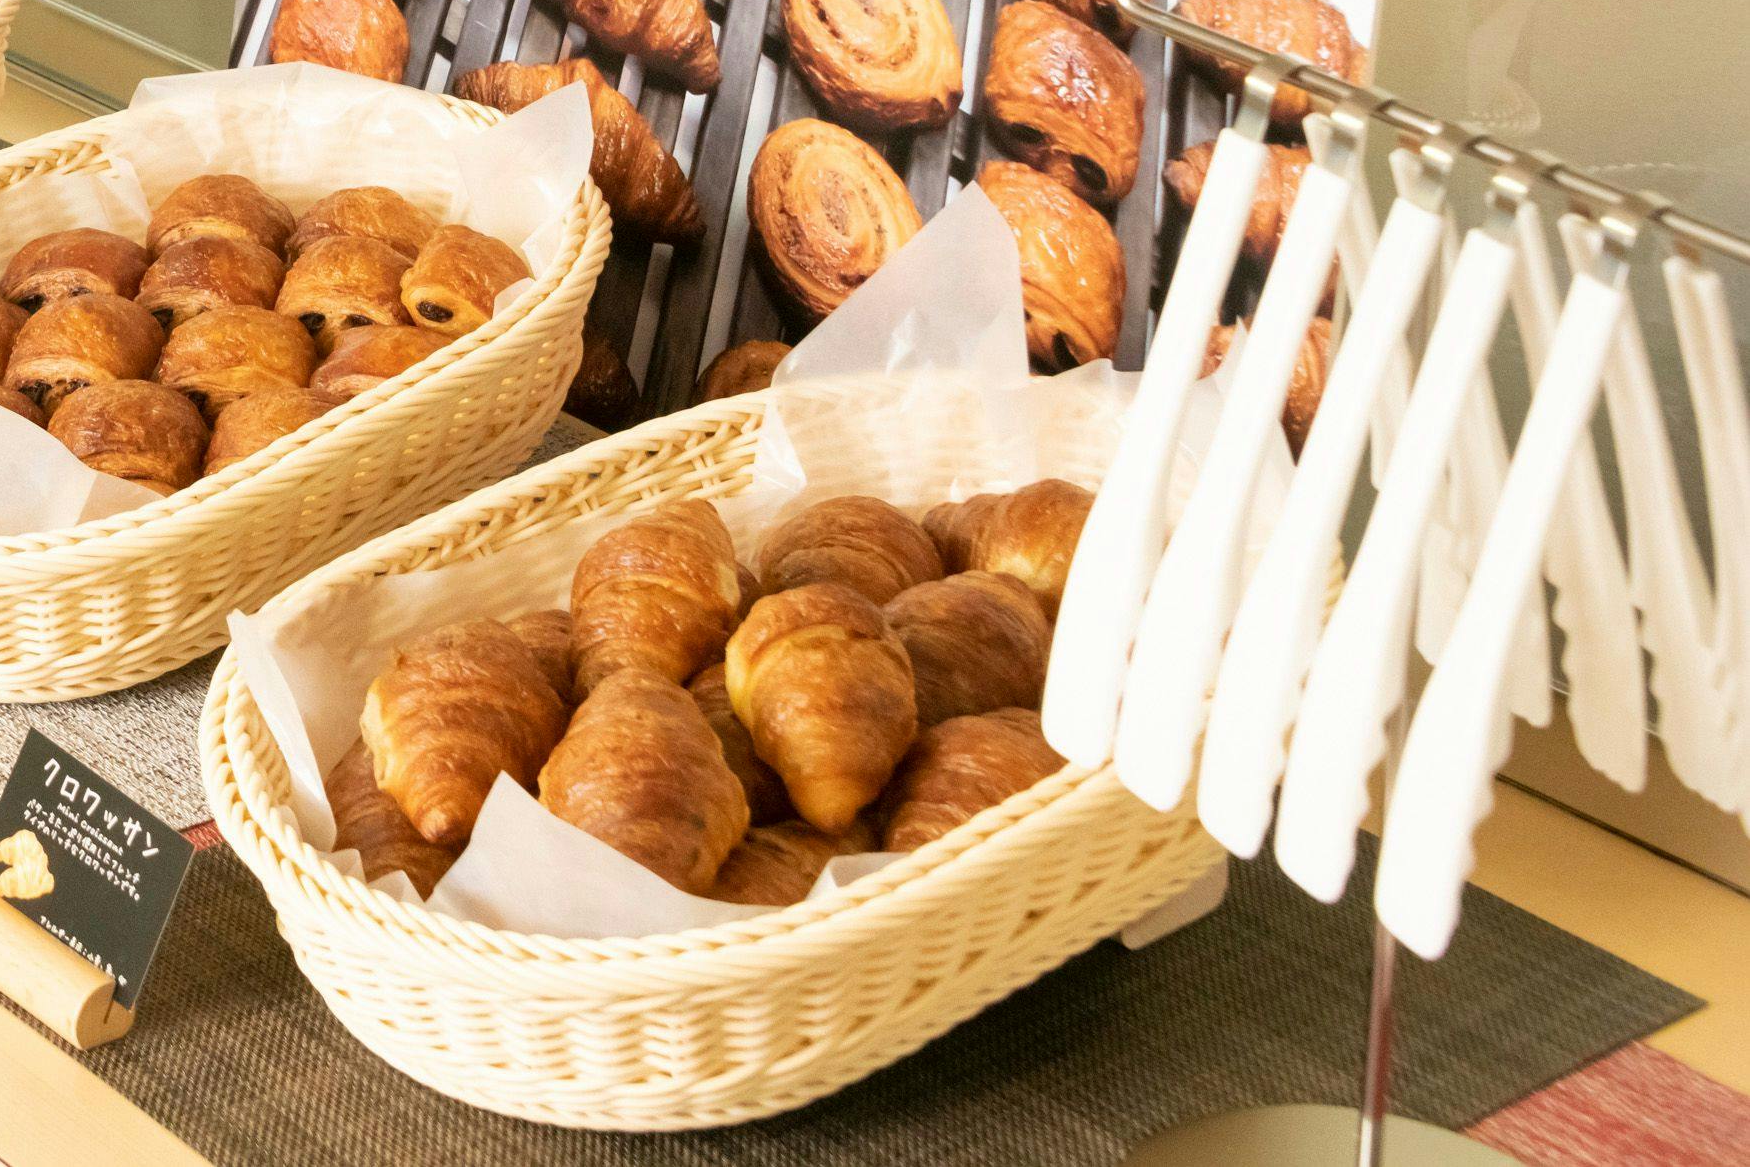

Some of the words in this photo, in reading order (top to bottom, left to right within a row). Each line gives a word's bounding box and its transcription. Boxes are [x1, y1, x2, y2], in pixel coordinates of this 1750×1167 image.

[43, 757, 159, 858] クロワッサン
[56, 801, 80, 824] Mini
[79, 818, 124, 856] Croissant
[22, 808, 140, 902] タイプのリッチなクロワッサンです。
